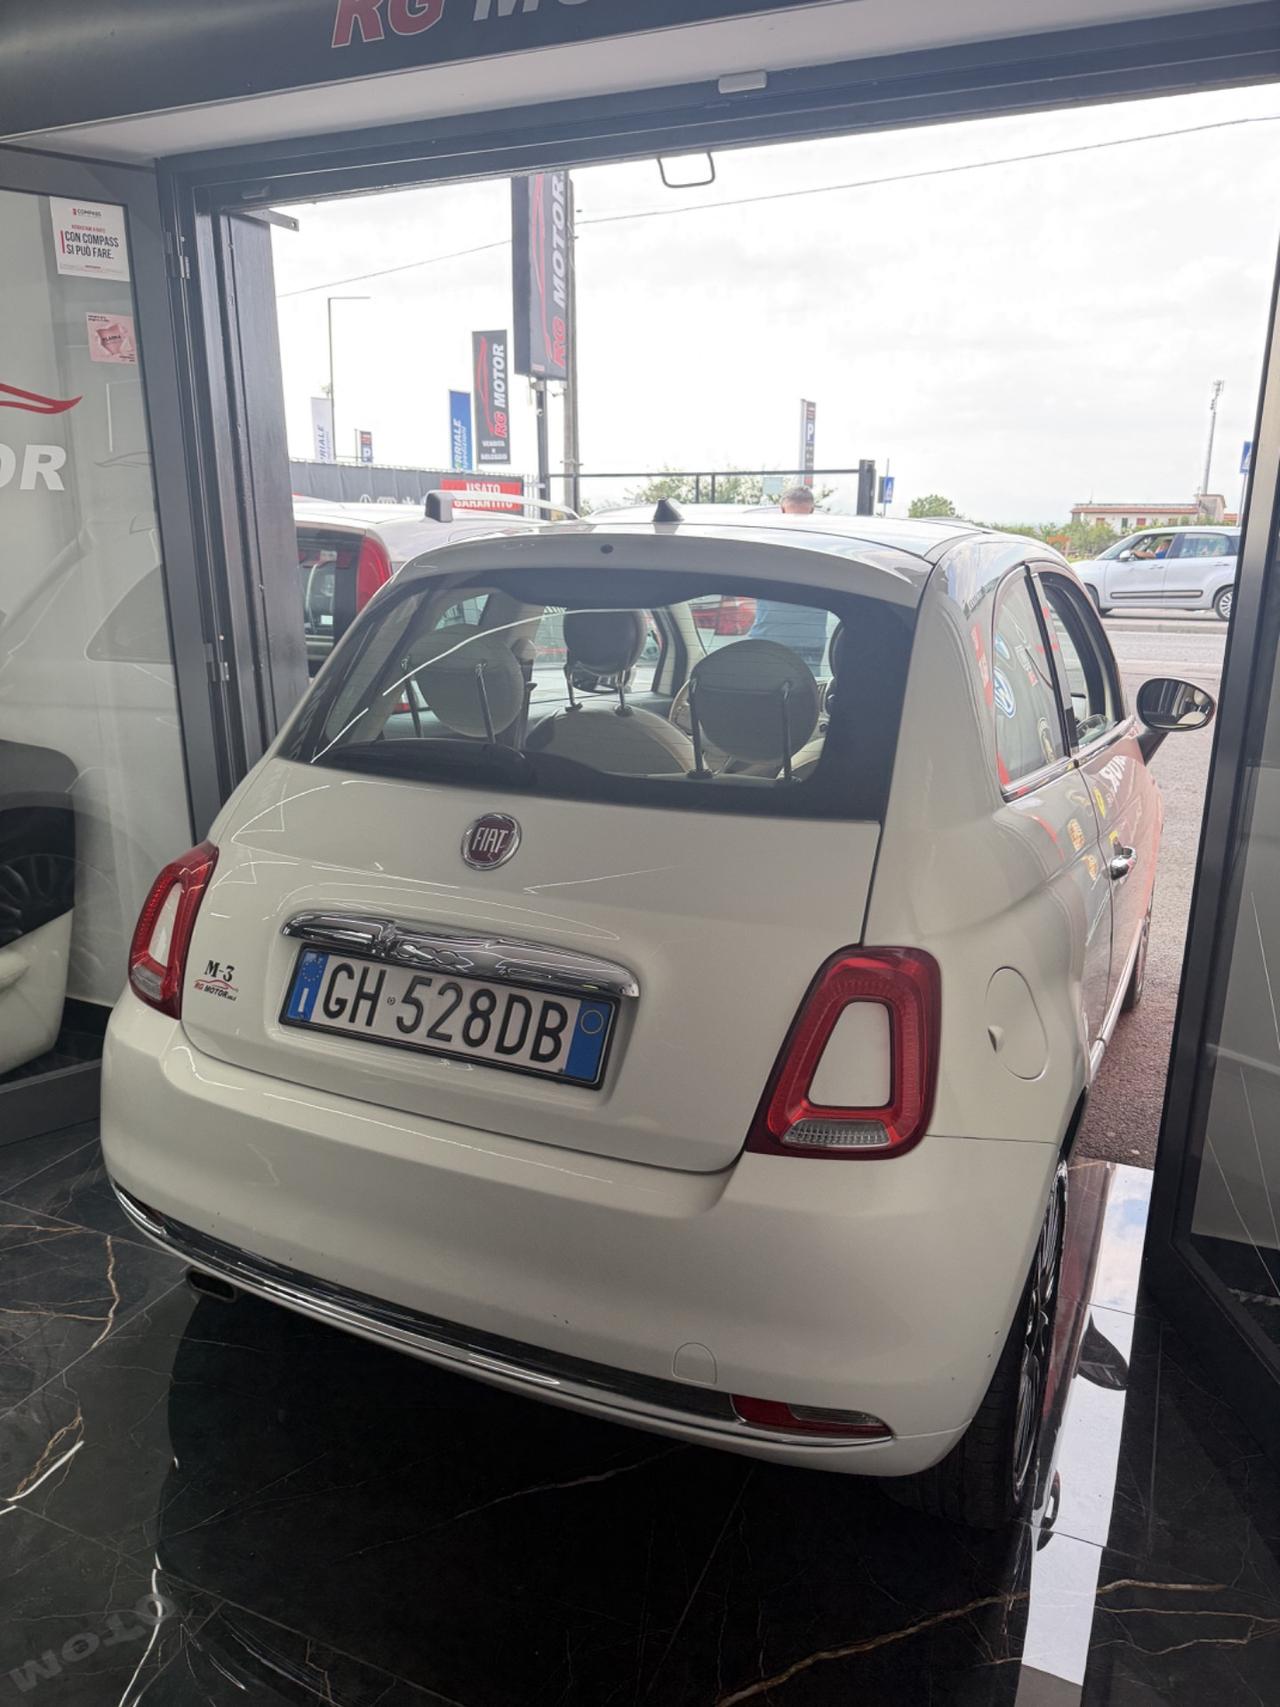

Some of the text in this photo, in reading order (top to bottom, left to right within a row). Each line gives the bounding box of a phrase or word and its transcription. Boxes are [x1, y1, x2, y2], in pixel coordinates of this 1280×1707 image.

[64, 230, 119, 248] CON COMPASS
[66, 243, 74, 255] SI
[551, 175, 566, 309] MOTOR
[492, 343, 506, 408] MOTOR
[465, 482, 501, 494] USATO
[472, 827, 508, 853] FIAT
